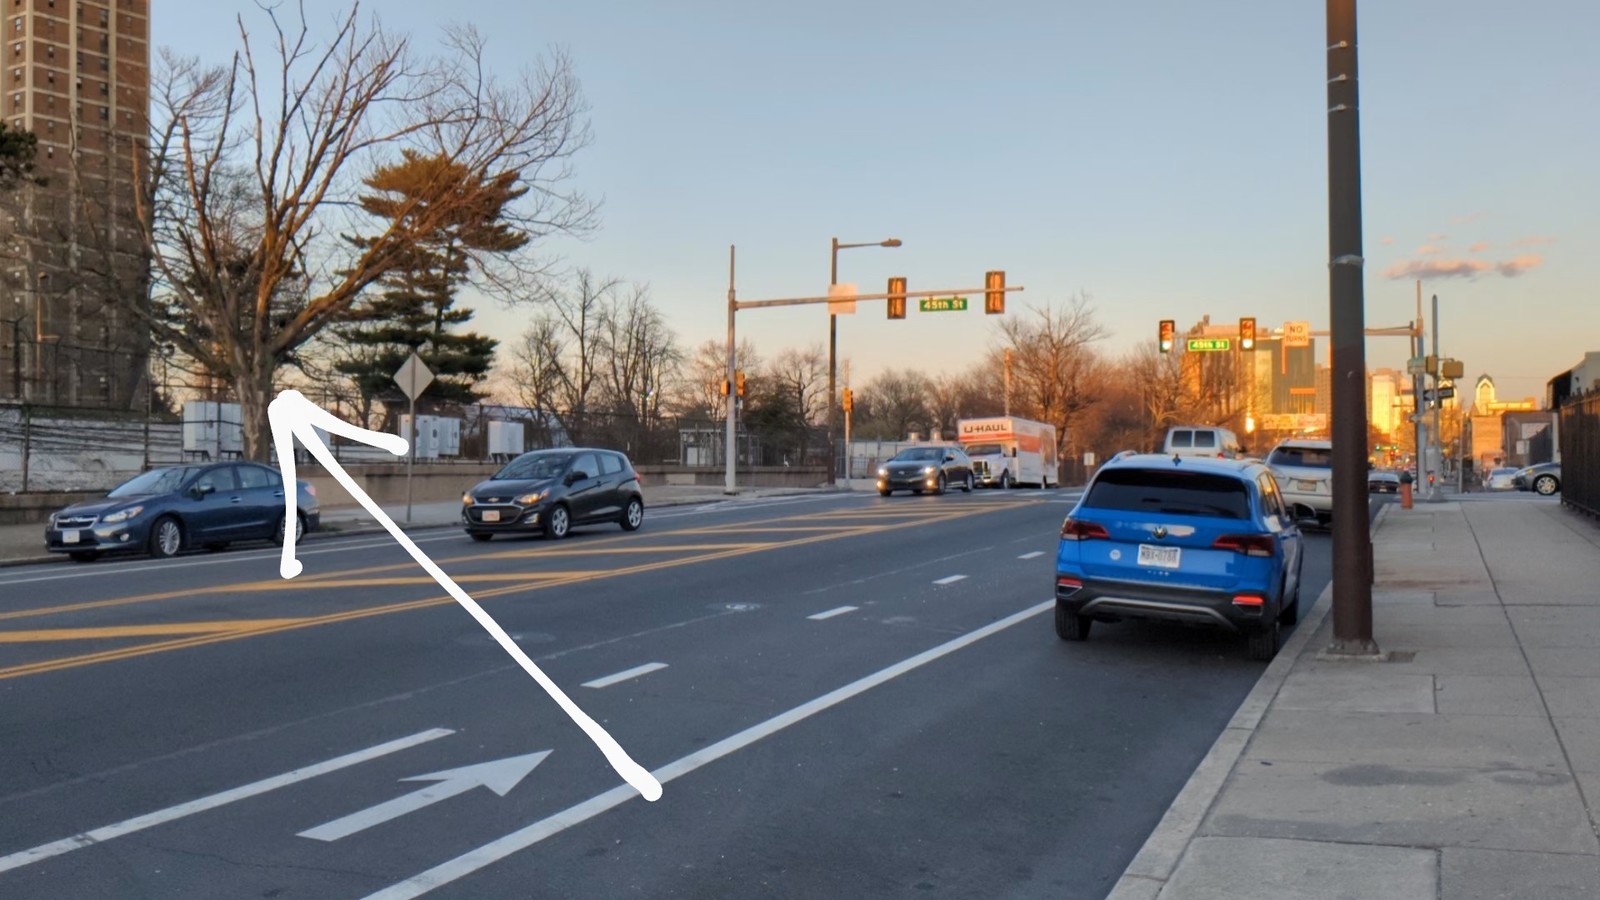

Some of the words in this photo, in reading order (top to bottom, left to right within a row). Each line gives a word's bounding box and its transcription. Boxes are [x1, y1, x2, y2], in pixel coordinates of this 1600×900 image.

[923, 300, 949, 309] 45th
[952, 300, 963, 309] St
[1289, 325, 1303, 333] NO
[963, 424, 1007, 434] U-HAUL
